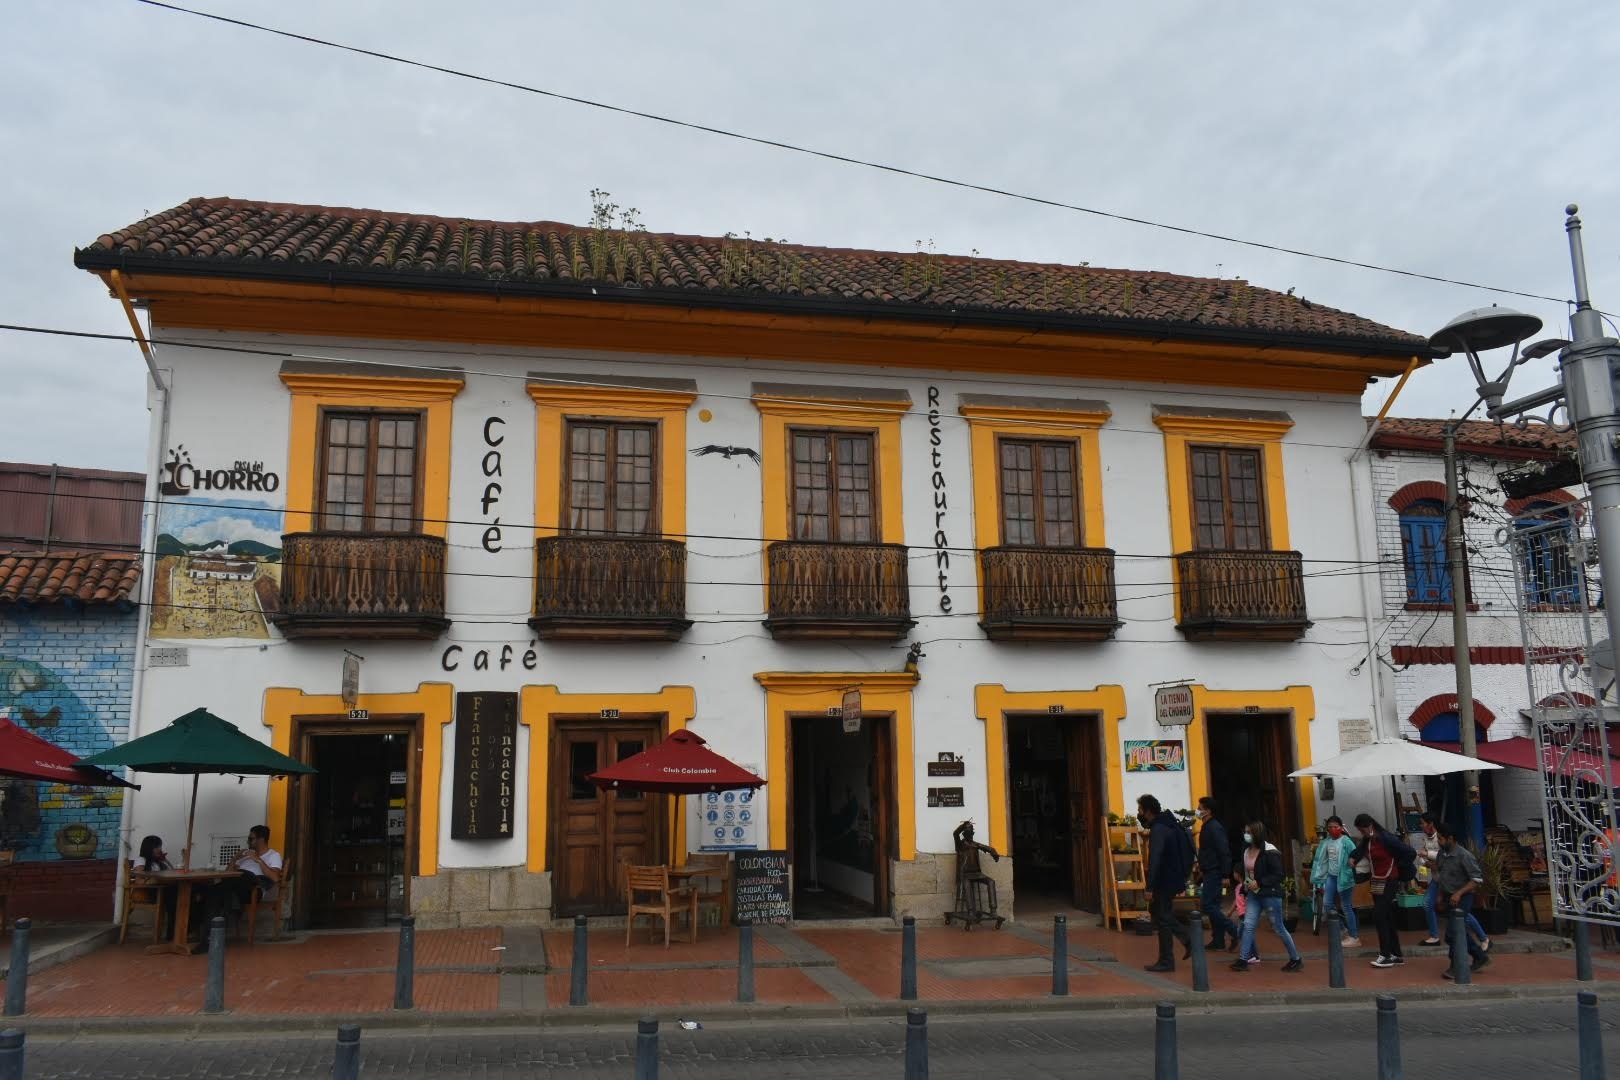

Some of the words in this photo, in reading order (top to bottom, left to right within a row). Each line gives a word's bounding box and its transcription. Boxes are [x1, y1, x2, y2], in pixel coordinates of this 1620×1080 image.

[173, 463, 279, 492] CHORRO
[234, 460, 250, 473] CASA
[252, 461, 263, 472] del
[481, 416, 506, 553] Café
[927, 386, 952, 613] Restaurante
[441, 639, 537, 672] Café
[1160, 694, 1168, 705] LA
[1168, 692, 1189, 704] TIENDA
[1168, 705, 1191, 717] CHORRO
[467, 696, 482, 834] Francachela
[740, 857, 786, 870] COLOMBIAN
